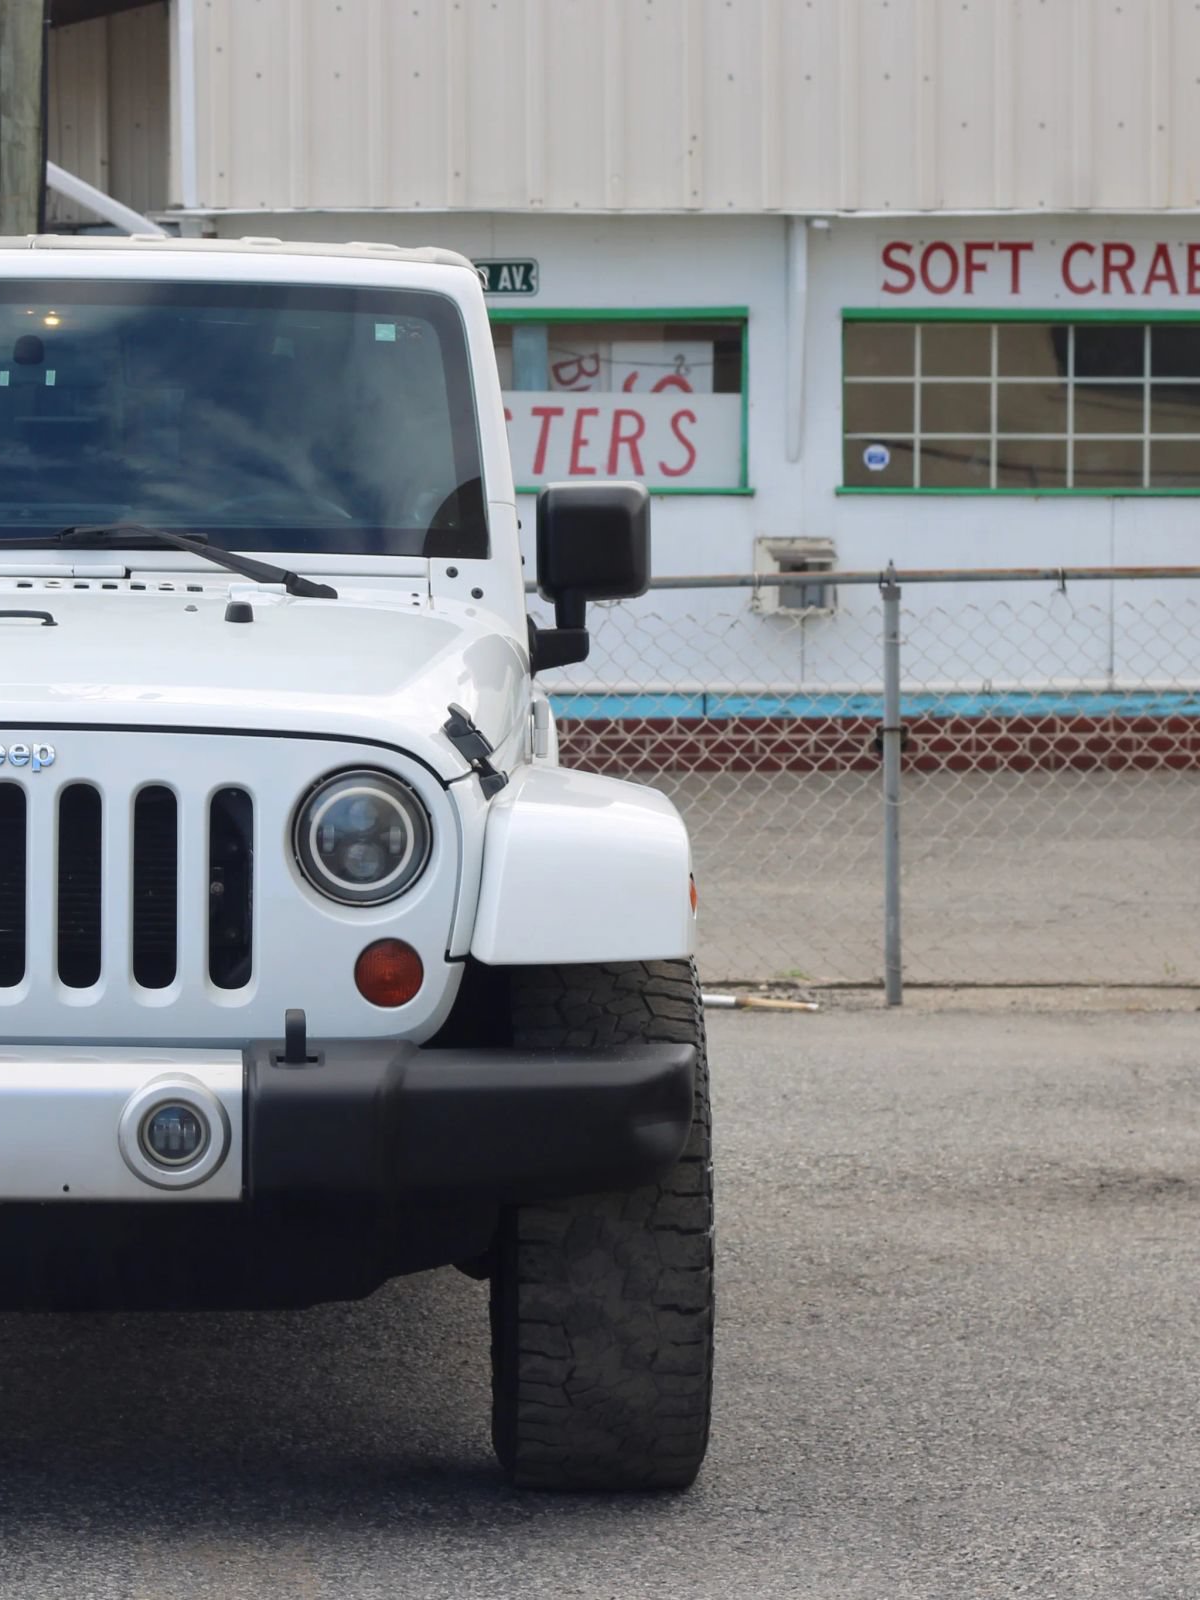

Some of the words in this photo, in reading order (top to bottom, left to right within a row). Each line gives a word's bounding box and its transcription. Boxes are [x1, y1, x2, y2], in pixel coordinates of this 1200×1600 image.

[497, 264, 528, 291] AV.
[881, 240, 1034, 295] SOFT
[504, 406, 698, 478] TERS
